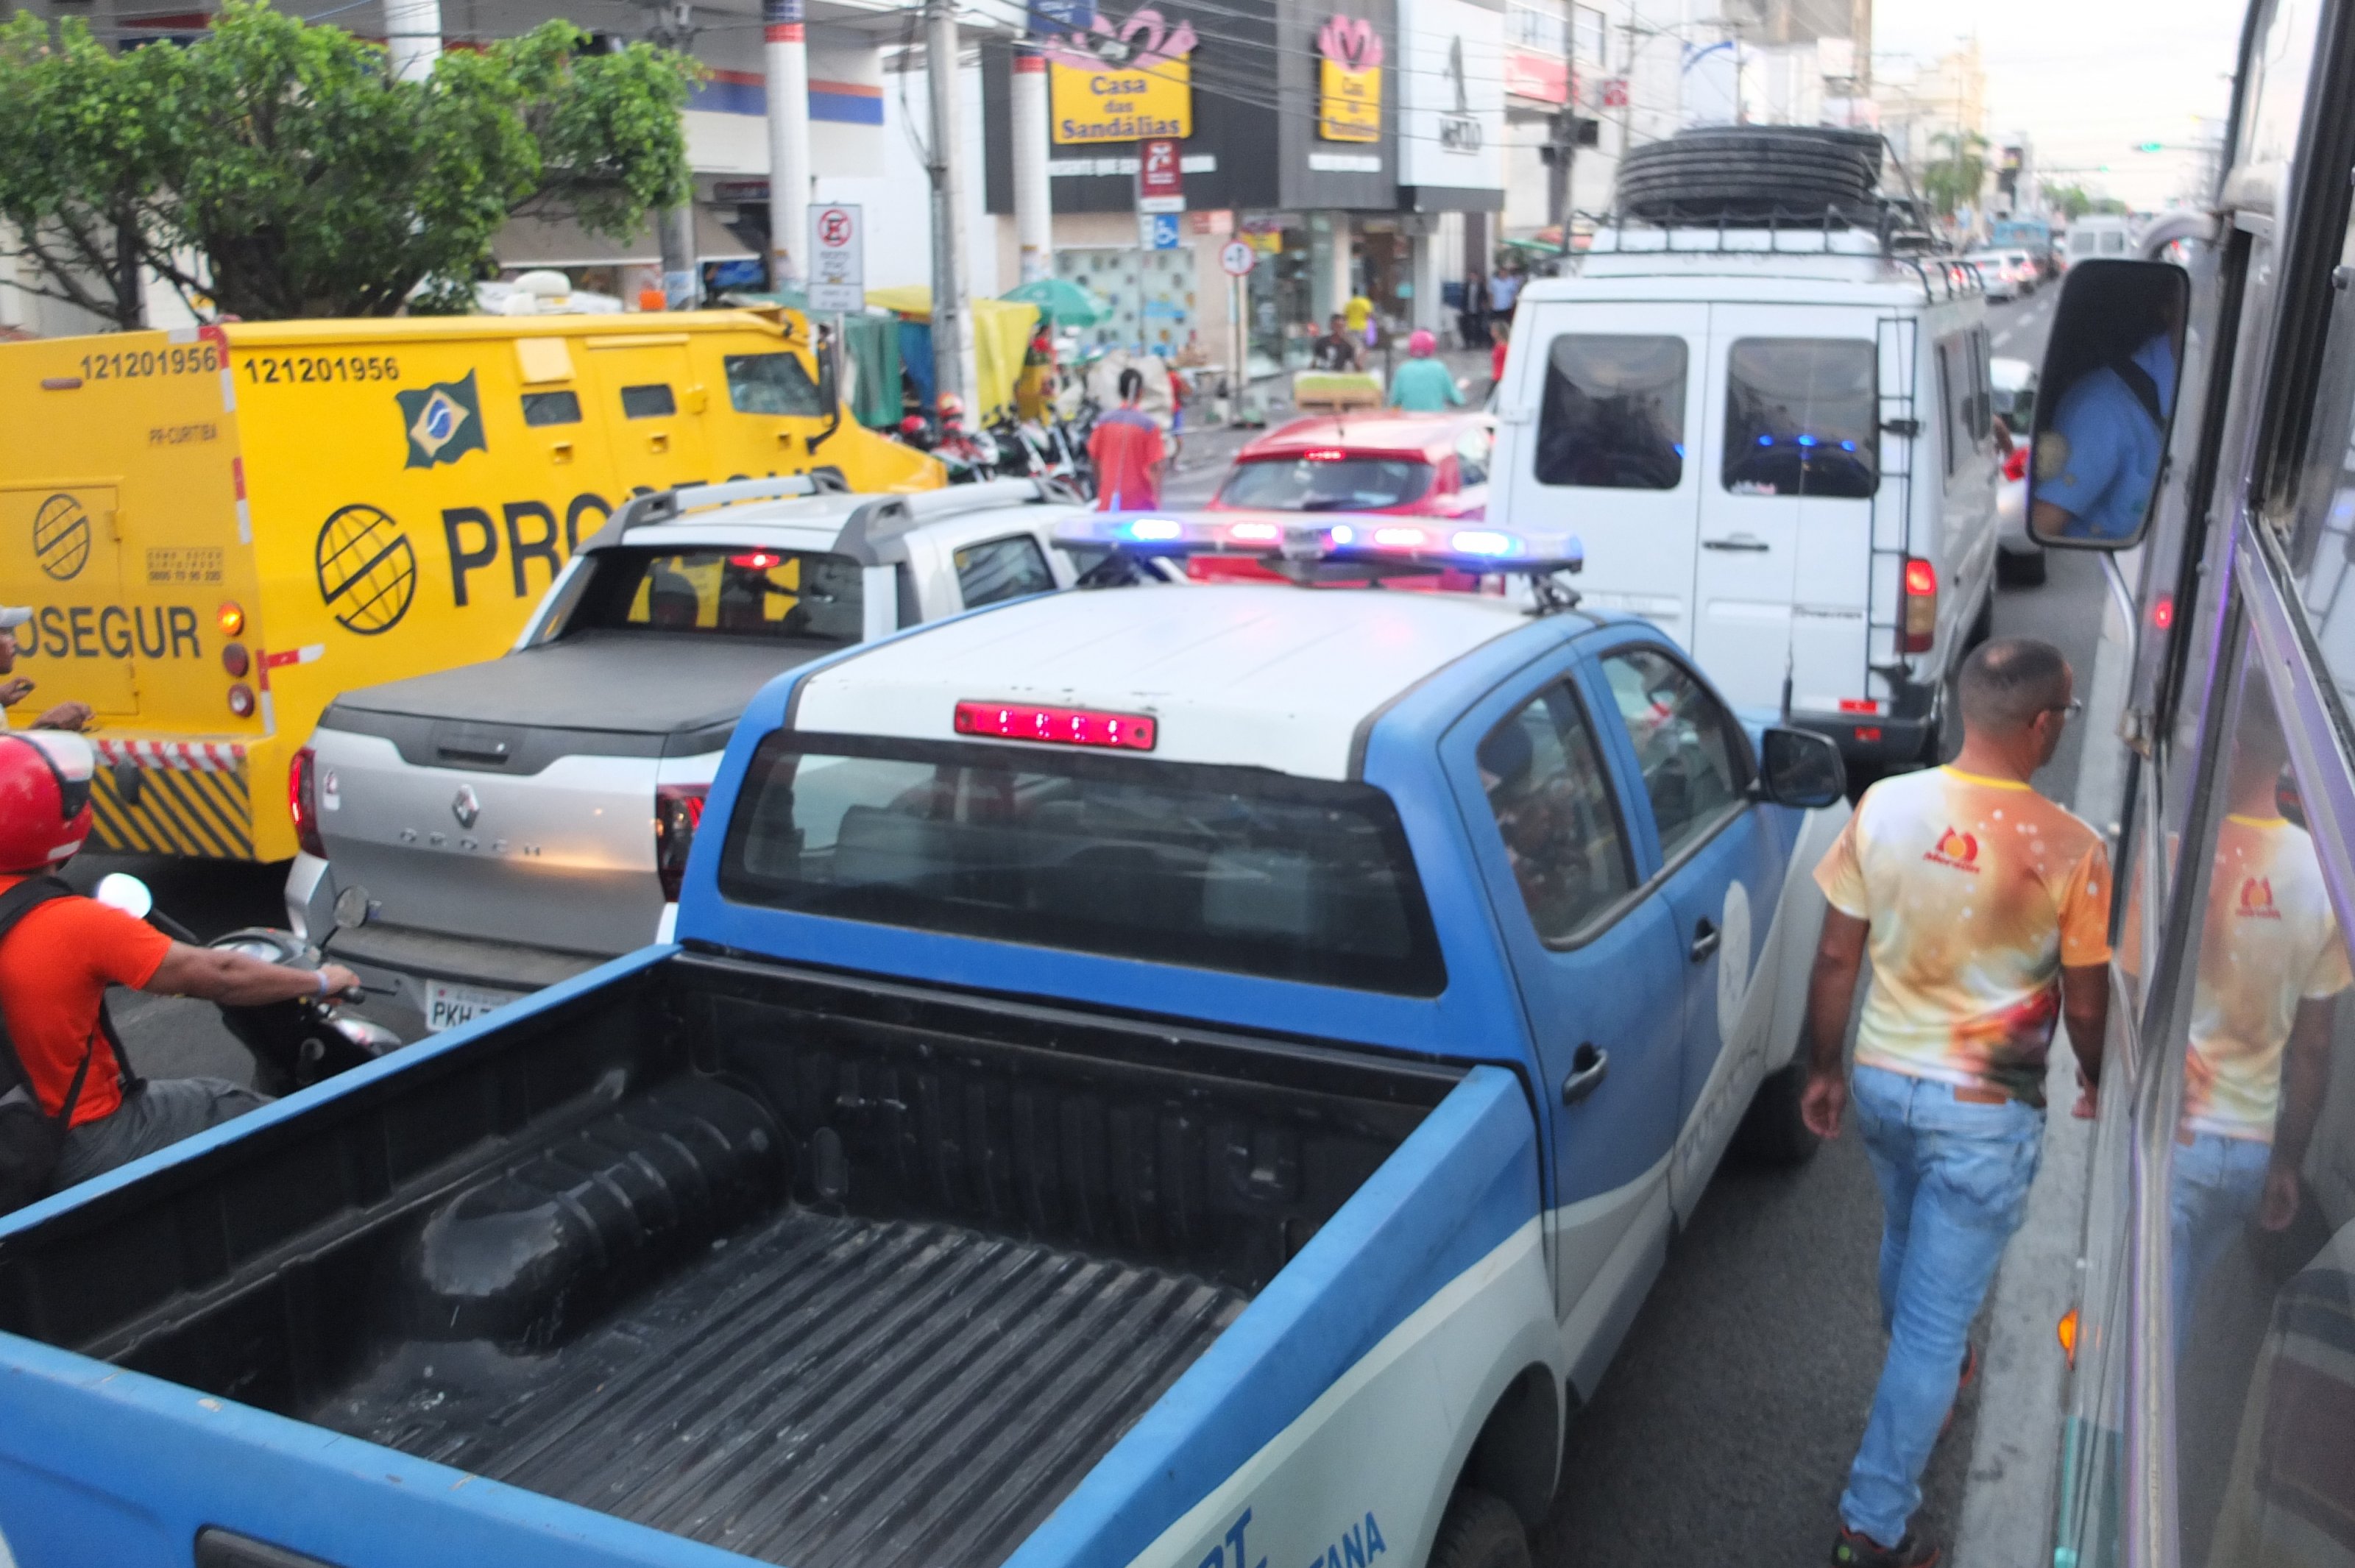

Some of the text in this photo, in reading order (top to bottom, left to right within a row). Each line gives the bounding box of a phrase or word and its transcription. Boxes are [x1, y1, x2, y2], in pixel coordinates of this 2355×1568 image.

[1091, 76, 1147, 95] Casa
[1105, 100, 1134, 114] das
[1062, 116, 1180, 139] Sandálias
[81, 347, 218, 380] 121201956
[245, 357, 400, 383] 121201956
[433, 1000, 492, 1027] PKH
